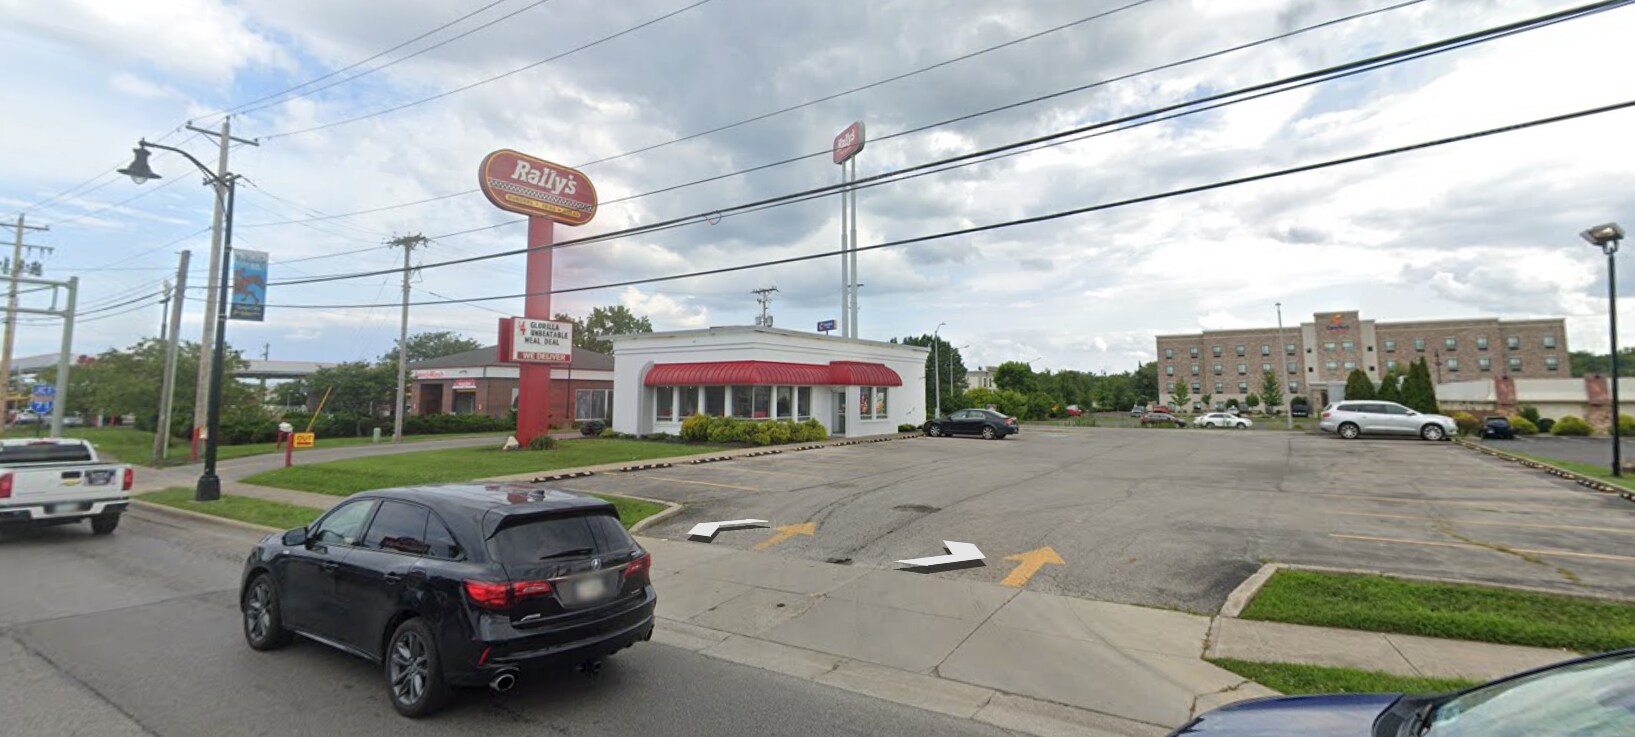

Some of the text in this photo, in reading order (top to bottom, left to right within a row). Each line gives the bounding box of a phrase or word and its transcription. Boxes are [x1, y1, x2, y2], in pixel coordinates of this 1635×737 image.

[511, 160, 577, 194] Rally's
[531, 322, 559, 330] GLORILLA
[531, 330, 568, 339] UNBEATABLE
[523, 352, 565, 361] WE DELIVER
